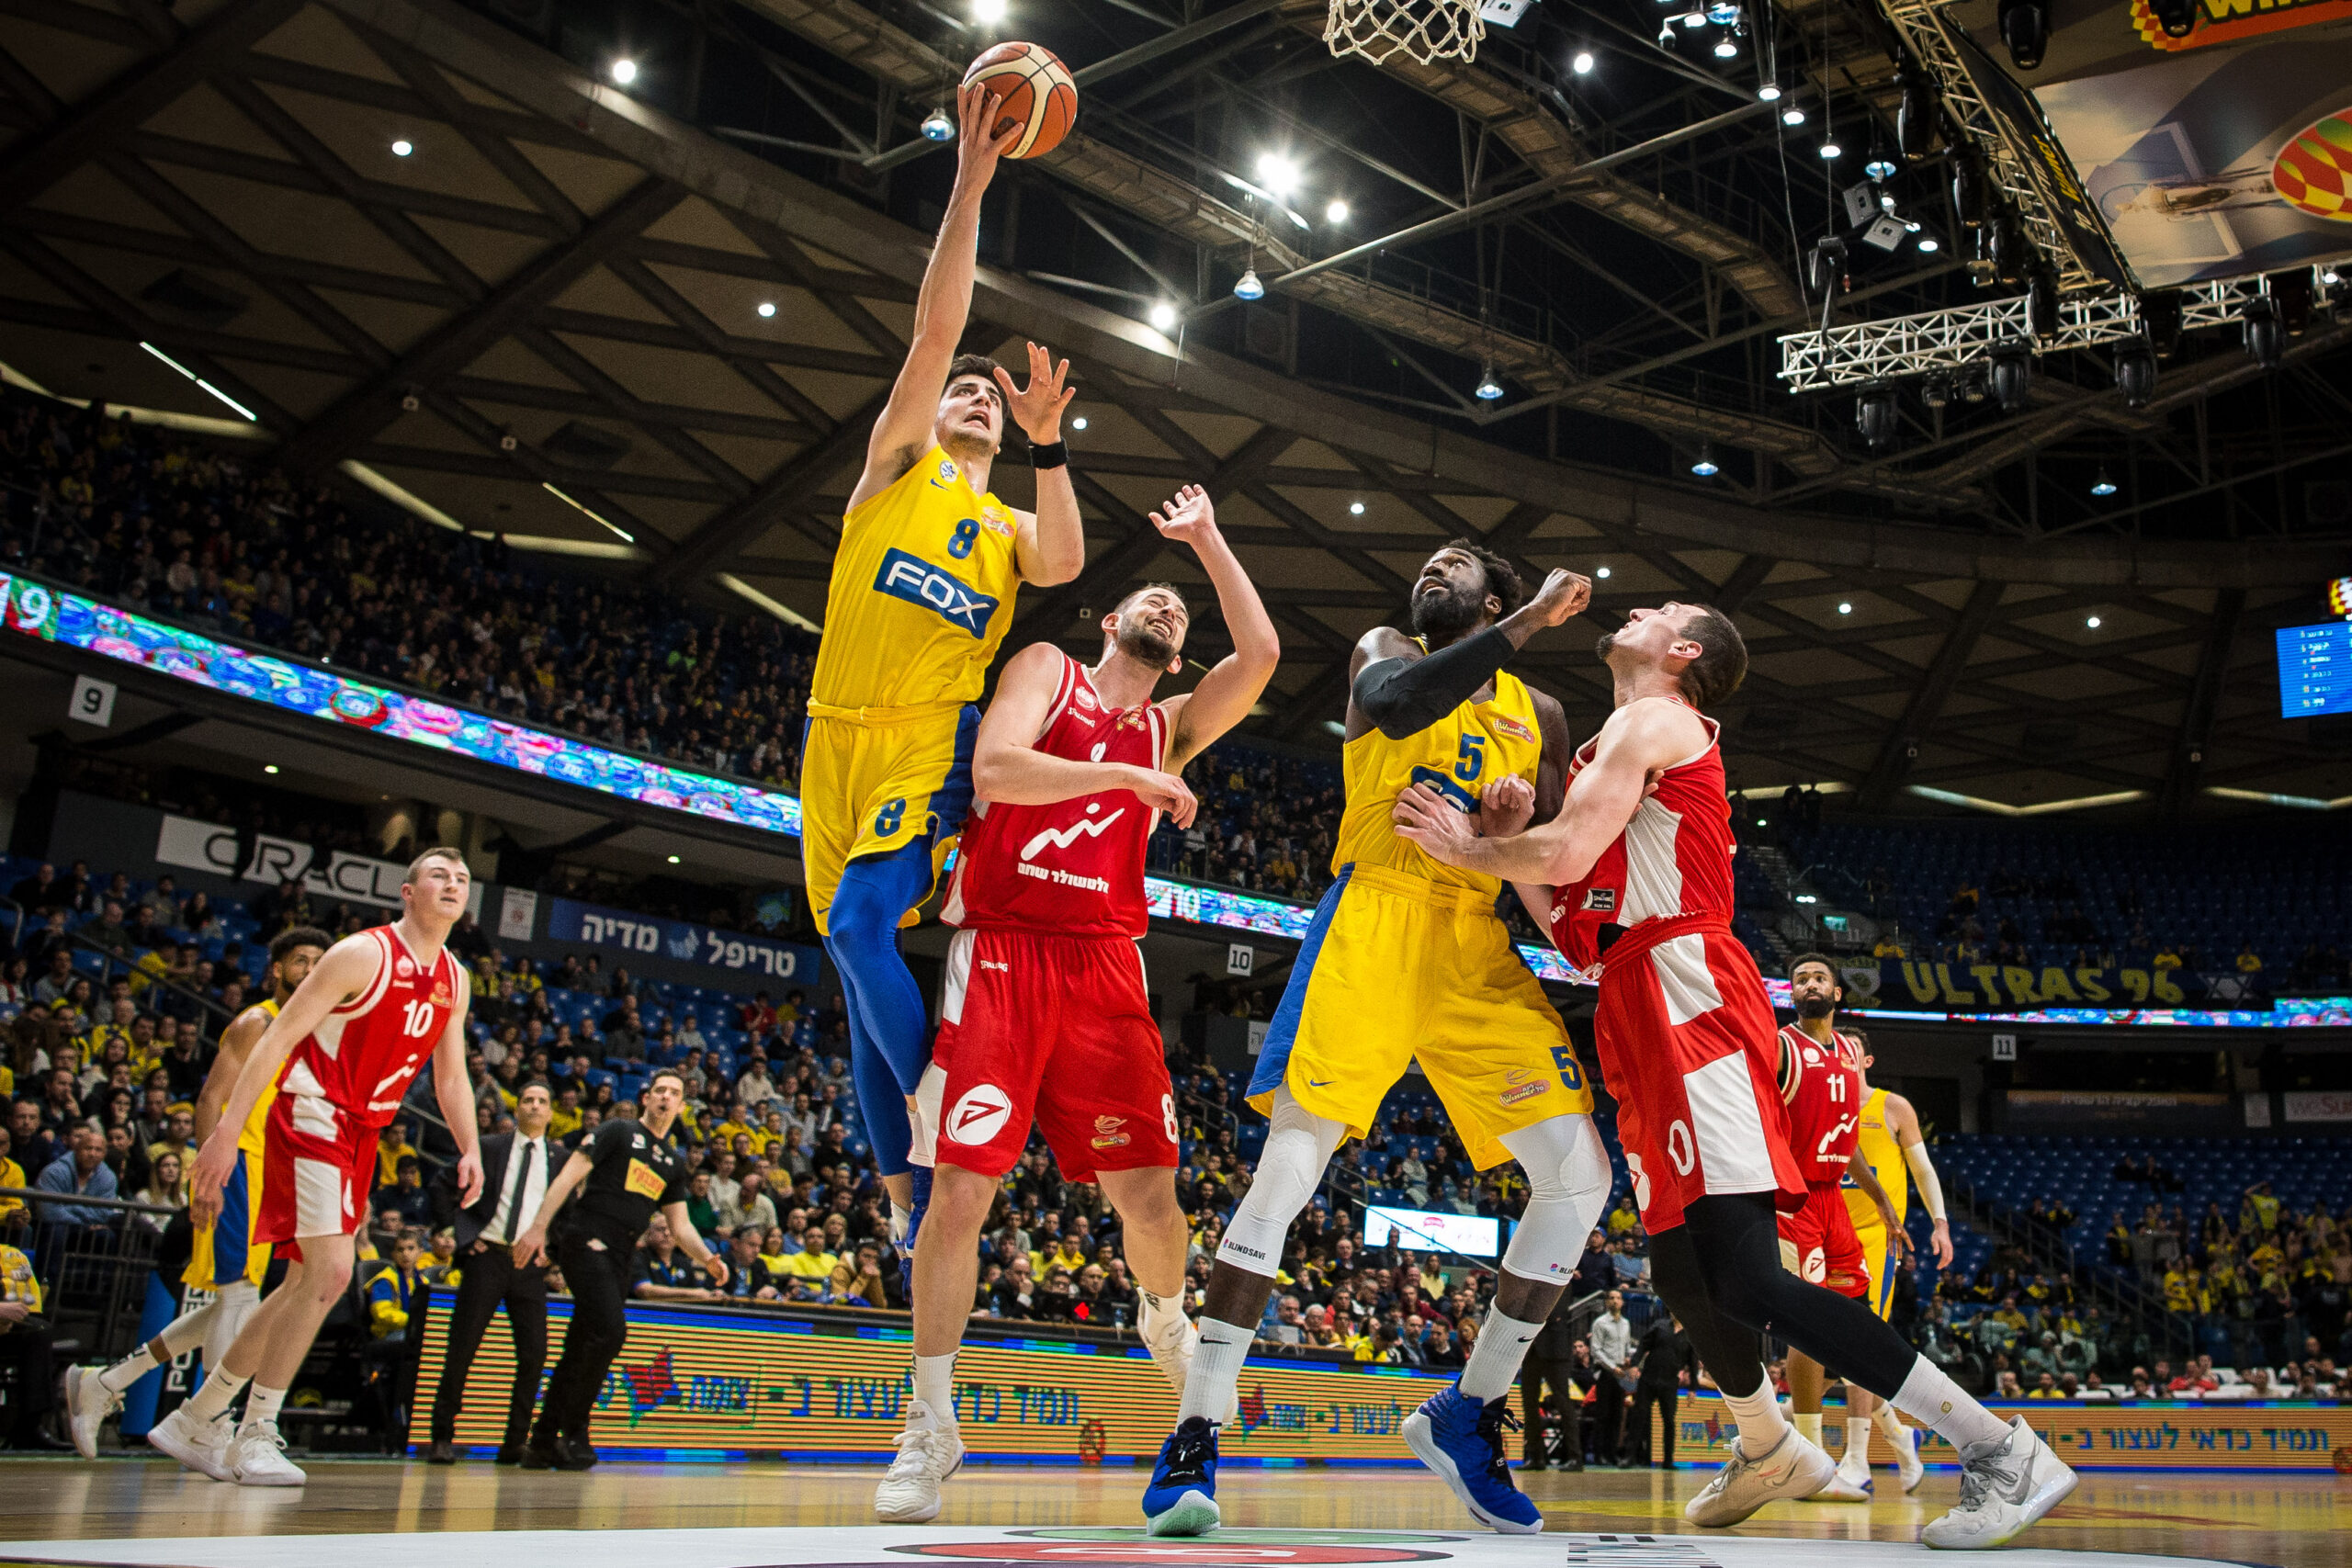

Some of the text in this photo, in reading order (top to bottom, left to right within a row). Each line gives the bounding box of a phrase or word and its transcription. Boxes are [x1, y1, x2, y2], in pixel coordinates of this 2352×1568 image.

[947, 519, 980, 559] 8
[18, 586, 52, 629] 9
[885, 560, 990, 629] FOX
[83, 689, 102, 714] 9
[1454, 732, 1486, 781] 5
[875, 798, 906, 838] 8
[581, 913, 797, 977] טריפל מדיה
[1230, 950, 1250, 970] 10
[1902, 962, 2185, 1005] ULTRAS 96
[402, 998, 435, 1038] 10
[1997, 1038, 2012, 1055] 11
[1549, 1045, 1583, 1090] 5
[1826, 1073, 1846, 1102] 11
[1668, 1120, 1694, 1177] 0
[1227, 1241, 1266, 1260] BLINDSAVE
[2101, 1421, 2180, 1450] לעצור
[2190, 1427, 2252, 1450] כדאי
[2262, 1427, 2329, 1450] תמיד
